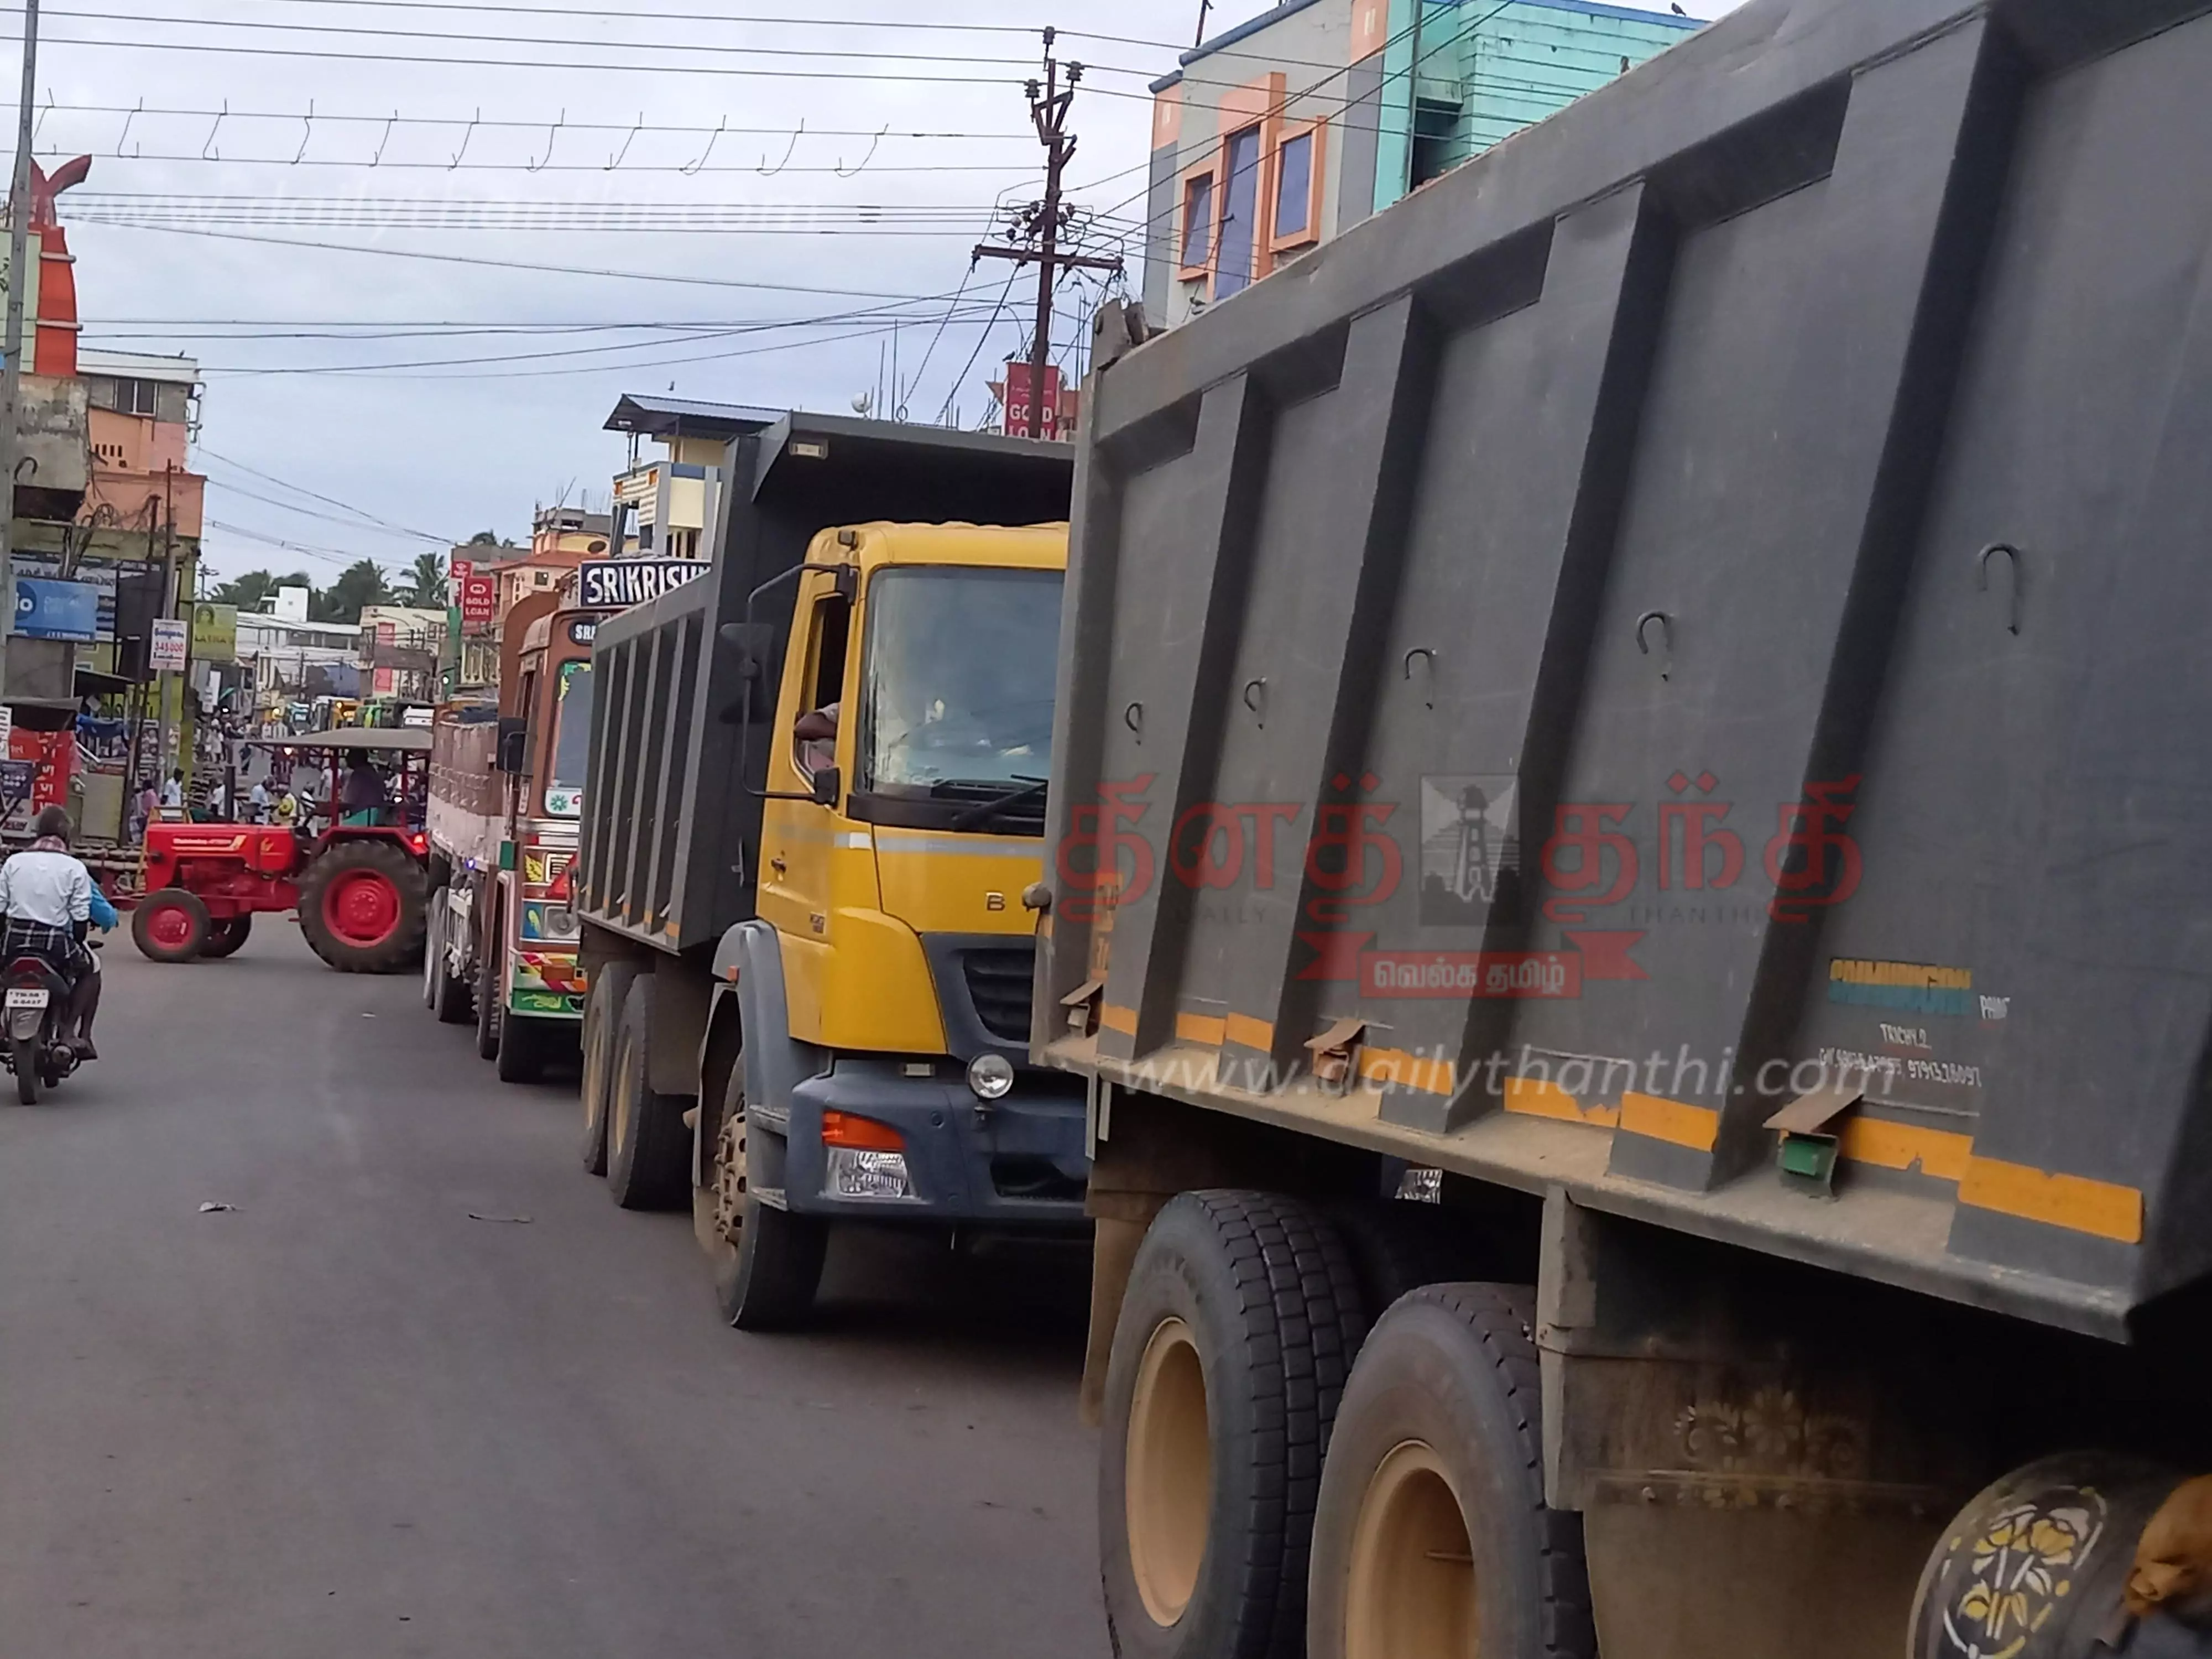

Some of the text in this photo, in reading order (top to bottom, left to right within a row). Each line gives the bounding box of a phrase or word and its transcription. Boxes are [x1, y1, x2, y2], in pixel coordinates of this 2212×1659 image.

[1010, 404, 1052, 423] GOD
[1008, 426, 1051, 441] LON
[15, 591, 33, 612] io
[466, 597, 490, 606] GOLD
[465, 607, 489, 615] LOAN
